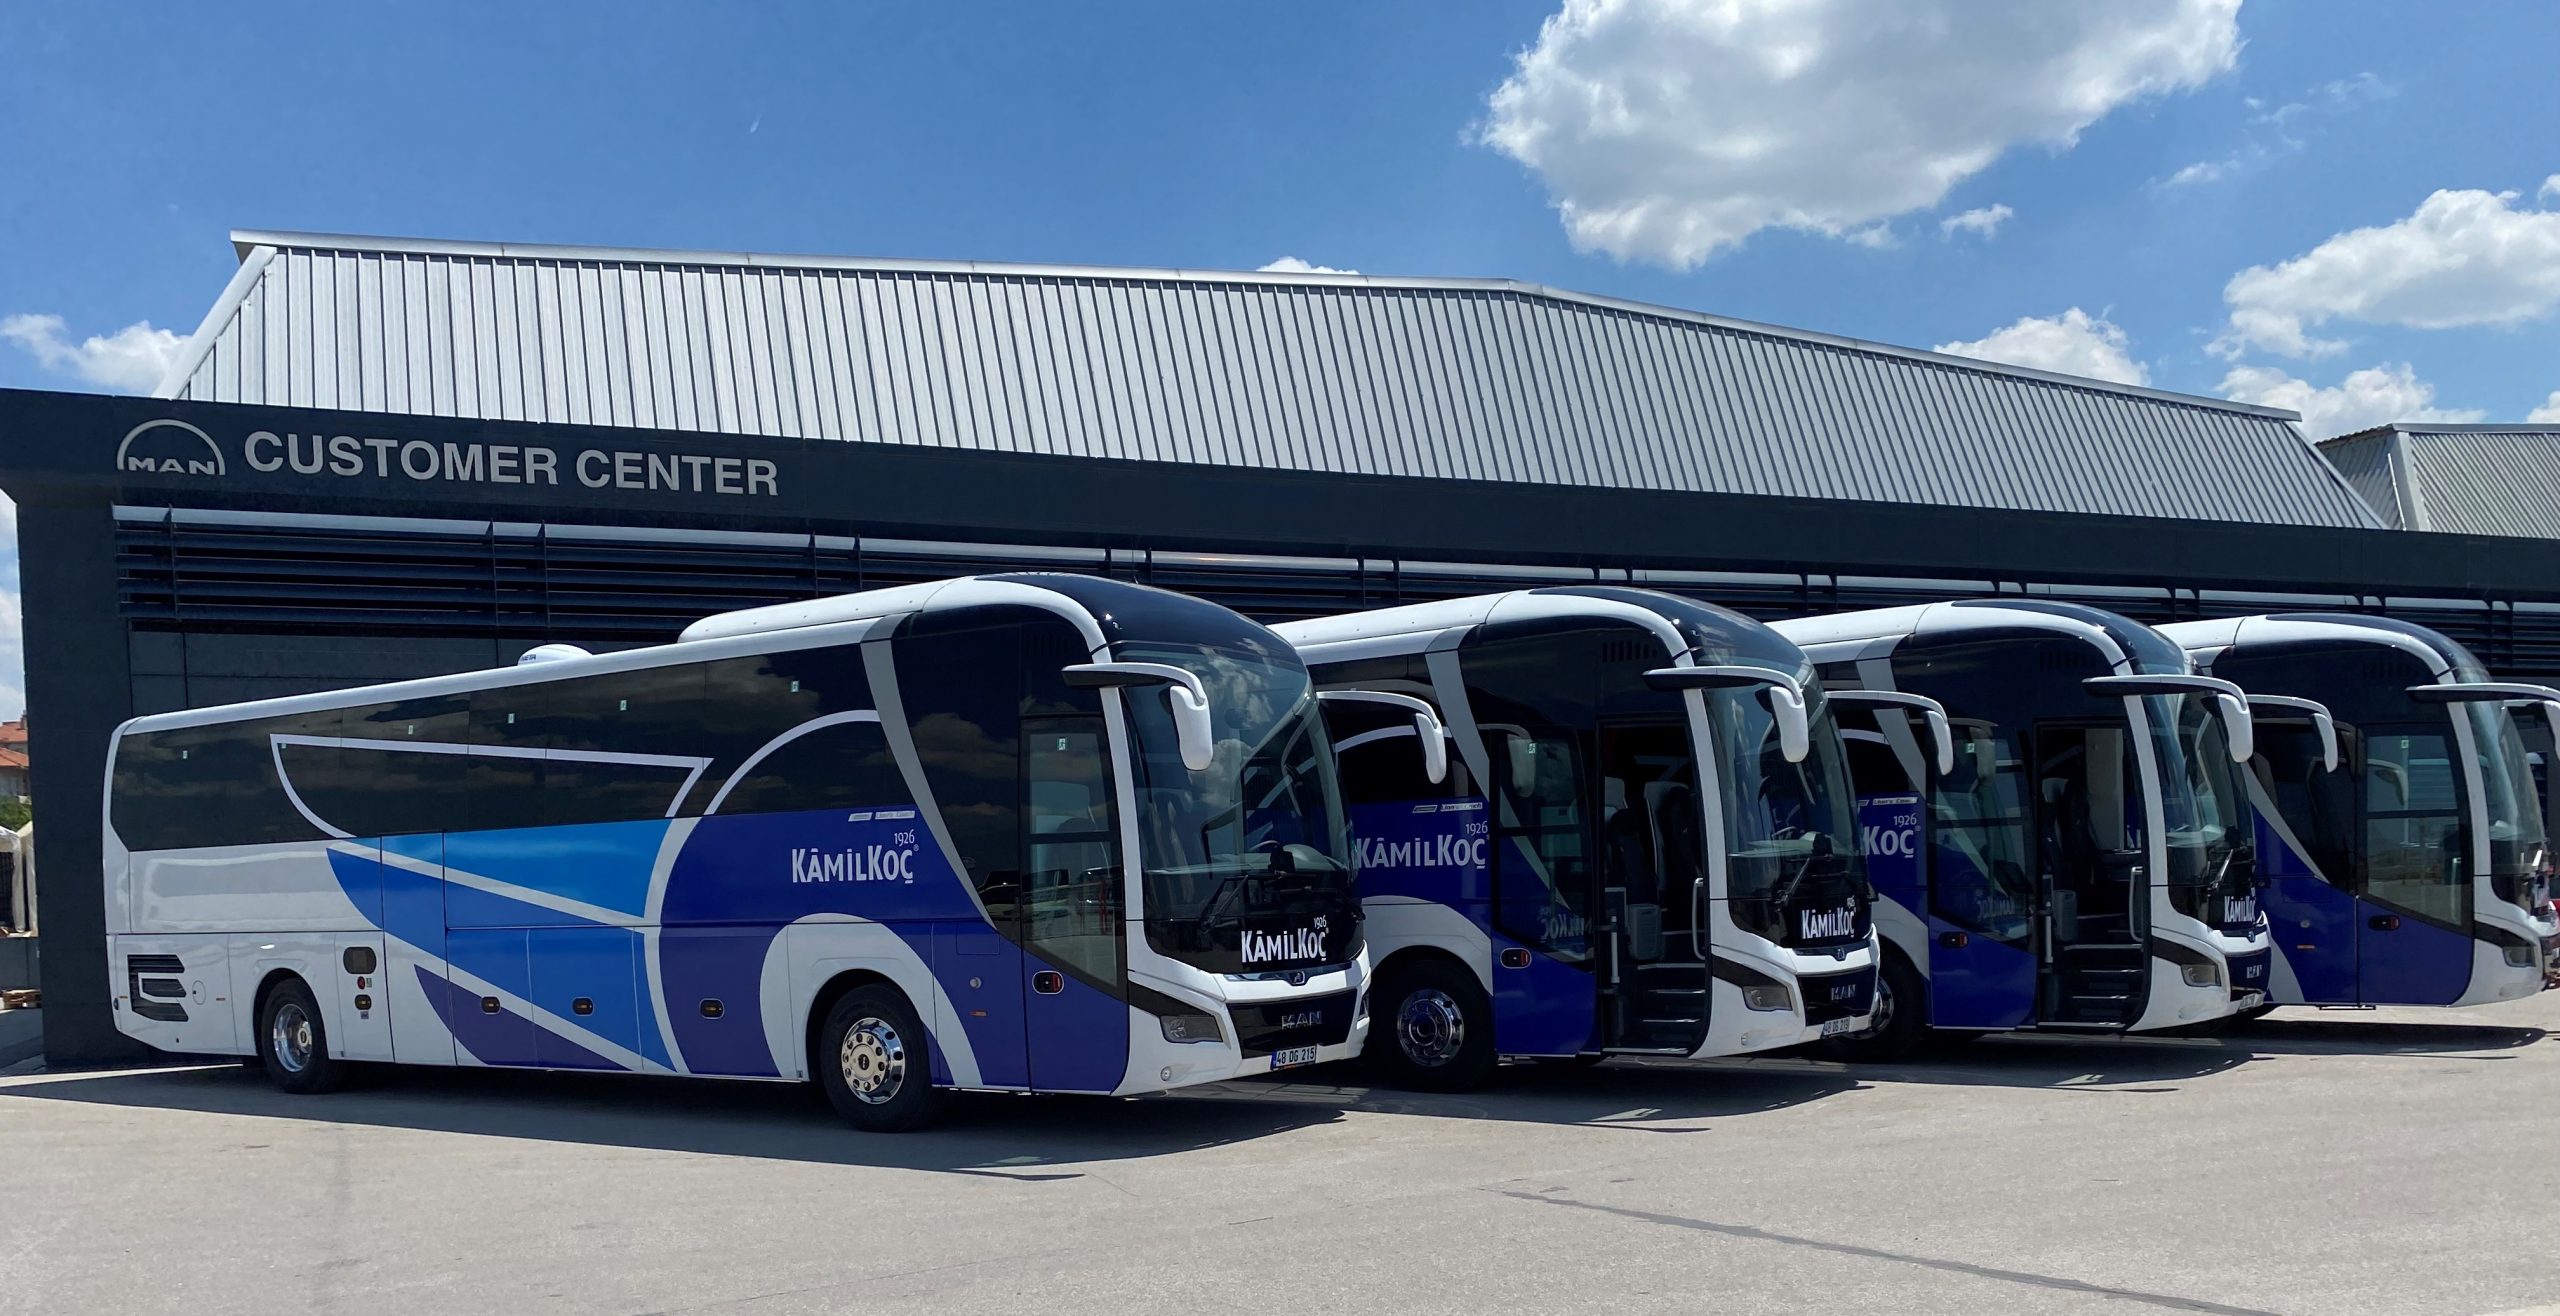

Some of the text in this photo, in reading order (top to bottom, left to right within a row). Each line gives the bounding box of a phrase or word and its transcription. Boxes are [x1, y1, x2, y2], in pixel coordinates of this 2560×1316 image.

[128, 456, 215, 475] MAN
[244, 430, 778, 496] CUSTOMER CENTER
[1894, 812, 1917, 827] 1926
[1466, 820, 1488, 837] 1926
[894, 829, 915, 846] 1926
[1314, 915, 1327, 930] 1926
[1276, 1047, 1315, 1064] 48 DG 215
